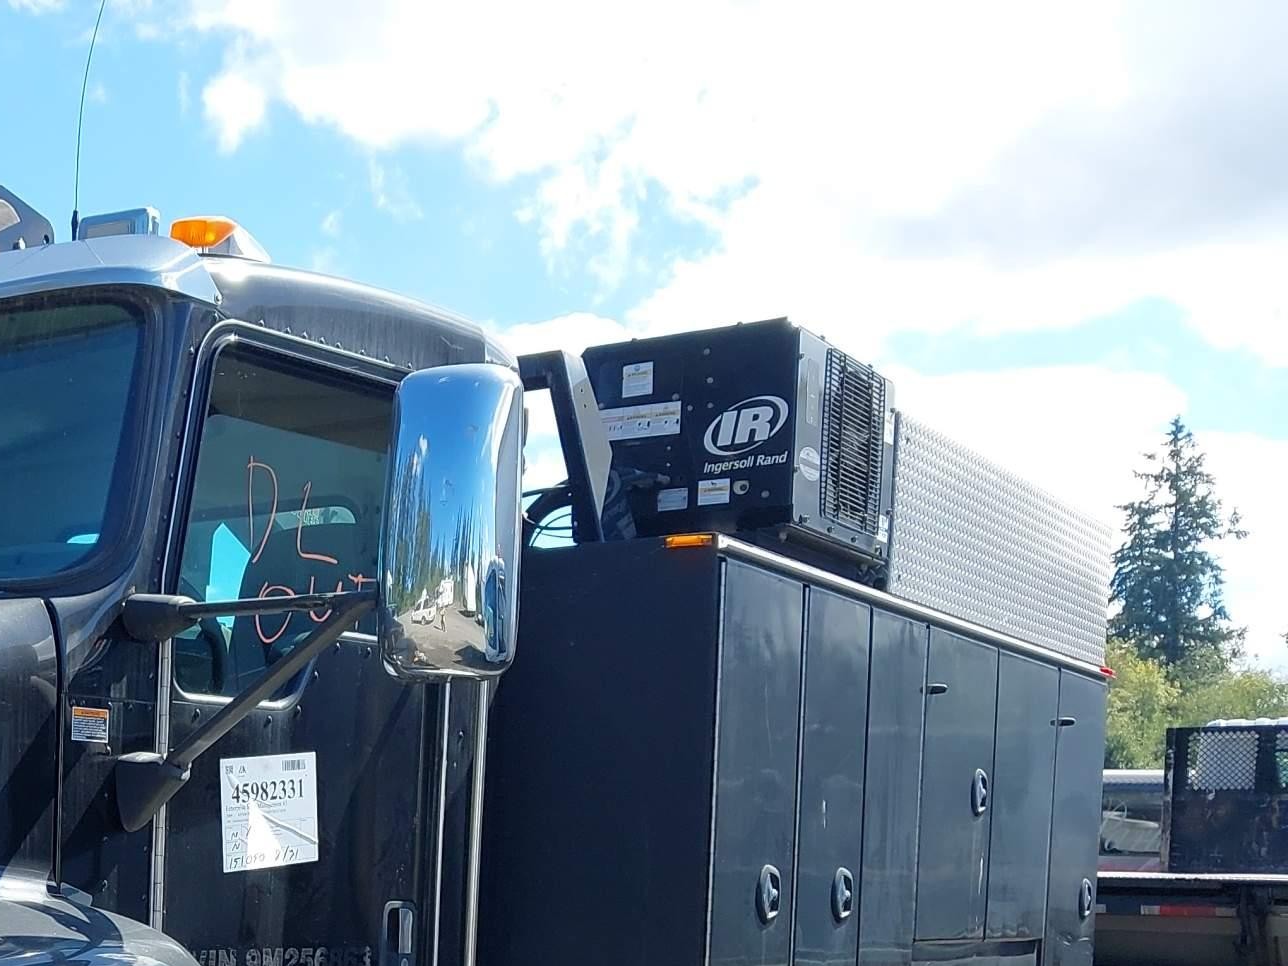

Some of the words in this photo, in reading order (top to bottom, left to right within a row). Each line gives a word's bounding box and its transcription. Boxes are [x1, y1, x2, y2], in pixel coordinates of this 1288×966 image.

[717, 406, 774, 447] IR
[704, 456, 755, 474] Ingersoll
[756, 451, 789, 466] Rand
[231, 779, 304, 804] 45982331
